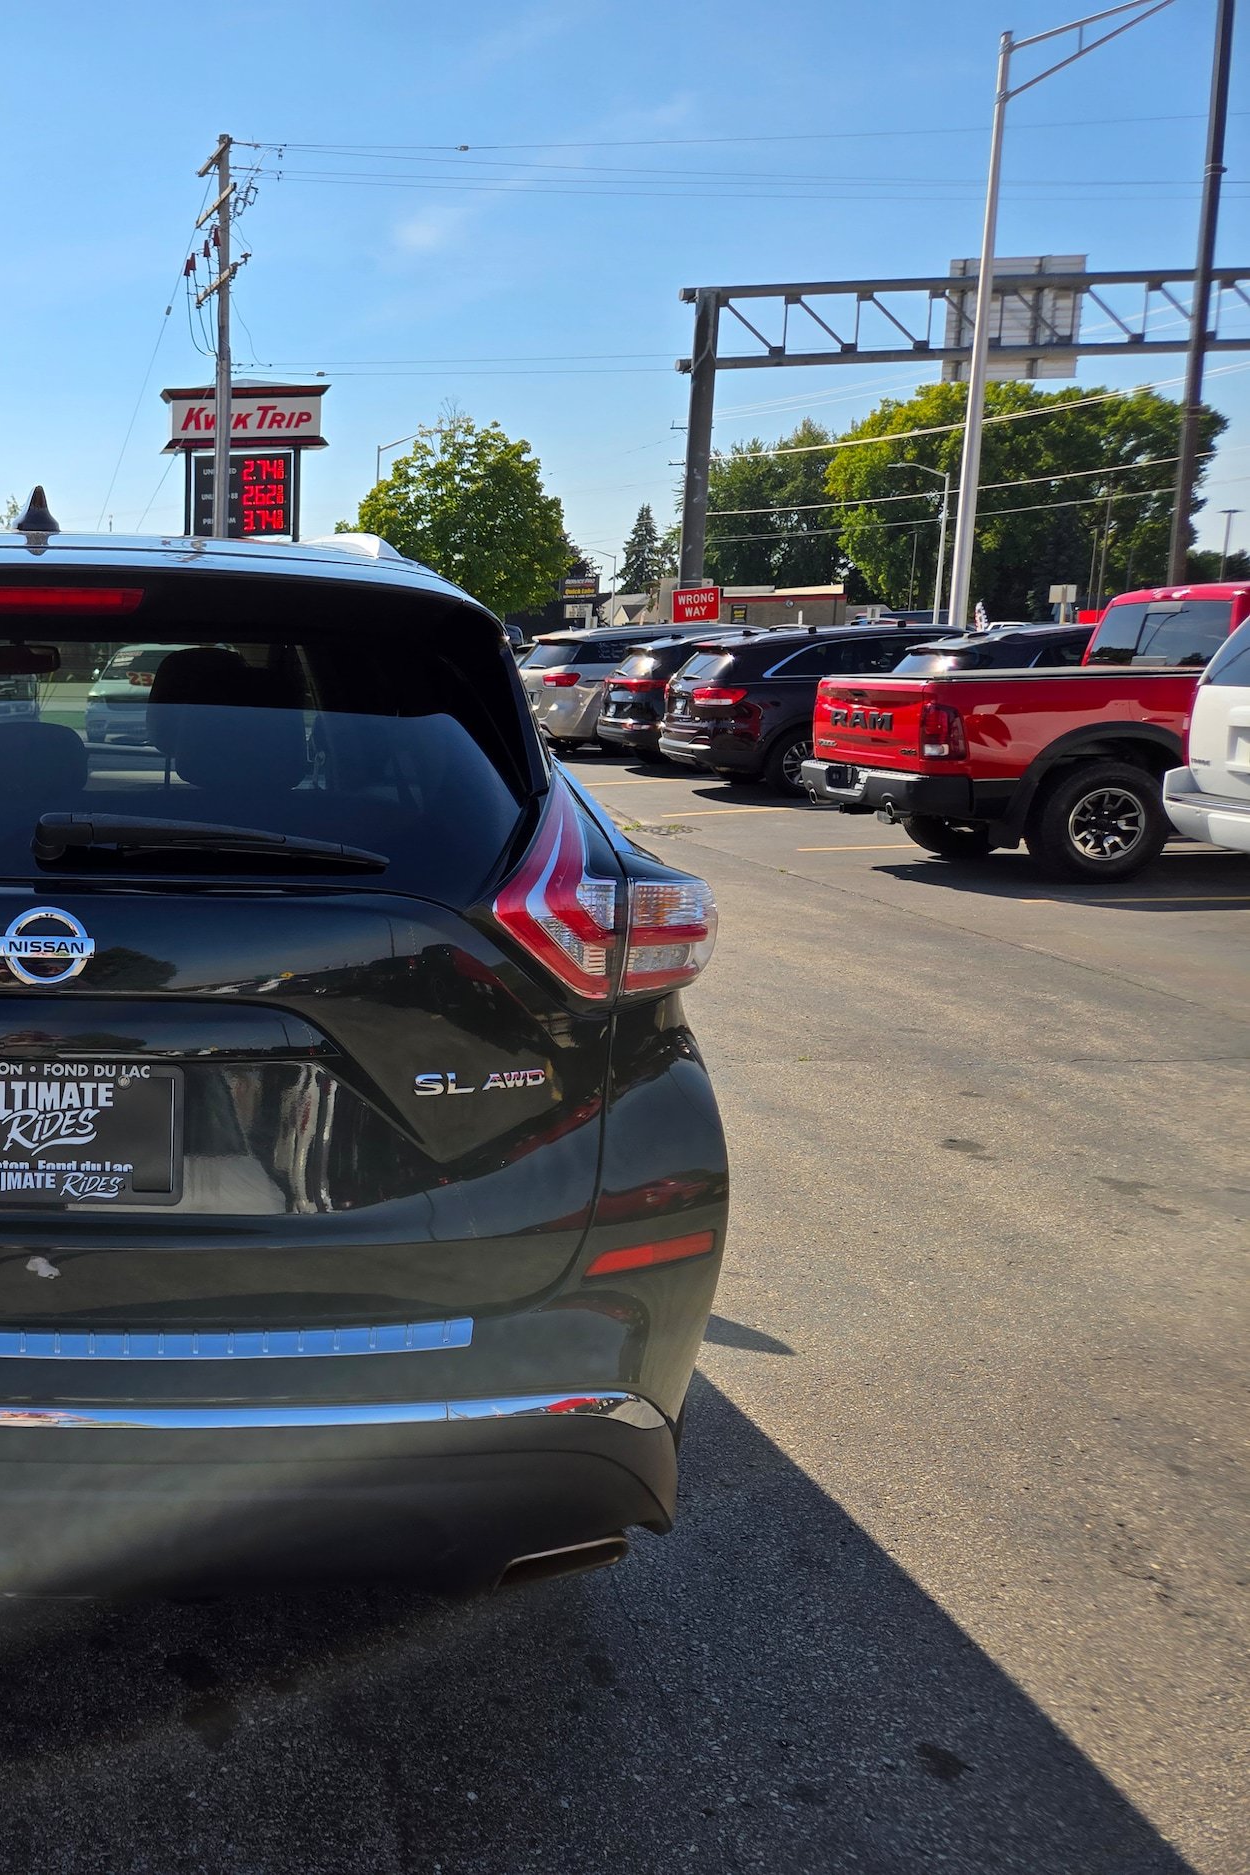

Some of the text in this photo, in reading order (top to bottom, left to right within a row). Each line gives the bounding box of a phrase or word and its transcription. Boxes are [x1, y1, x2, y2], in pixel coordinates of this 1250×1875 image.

[256, 406, 312, 429] TRIP
[243, 459, 277, 481] 2.74
[243, 485, 277, 506] 2.62
[243, 510, 277, 531] 3.74
[678, 592, 715, 605] WRONG
[685, 606, 707, 617] WAY
[830, 708, 894, 731] RAM
[8, 941, 85, 954] NISSAN
[43, 1063, 90, 1077] FOND
[94, 1064, 116, 1078] DU
[121, 1065, 151, 1079] LAC
[414, 1069, 546, 1096] SL AWD
